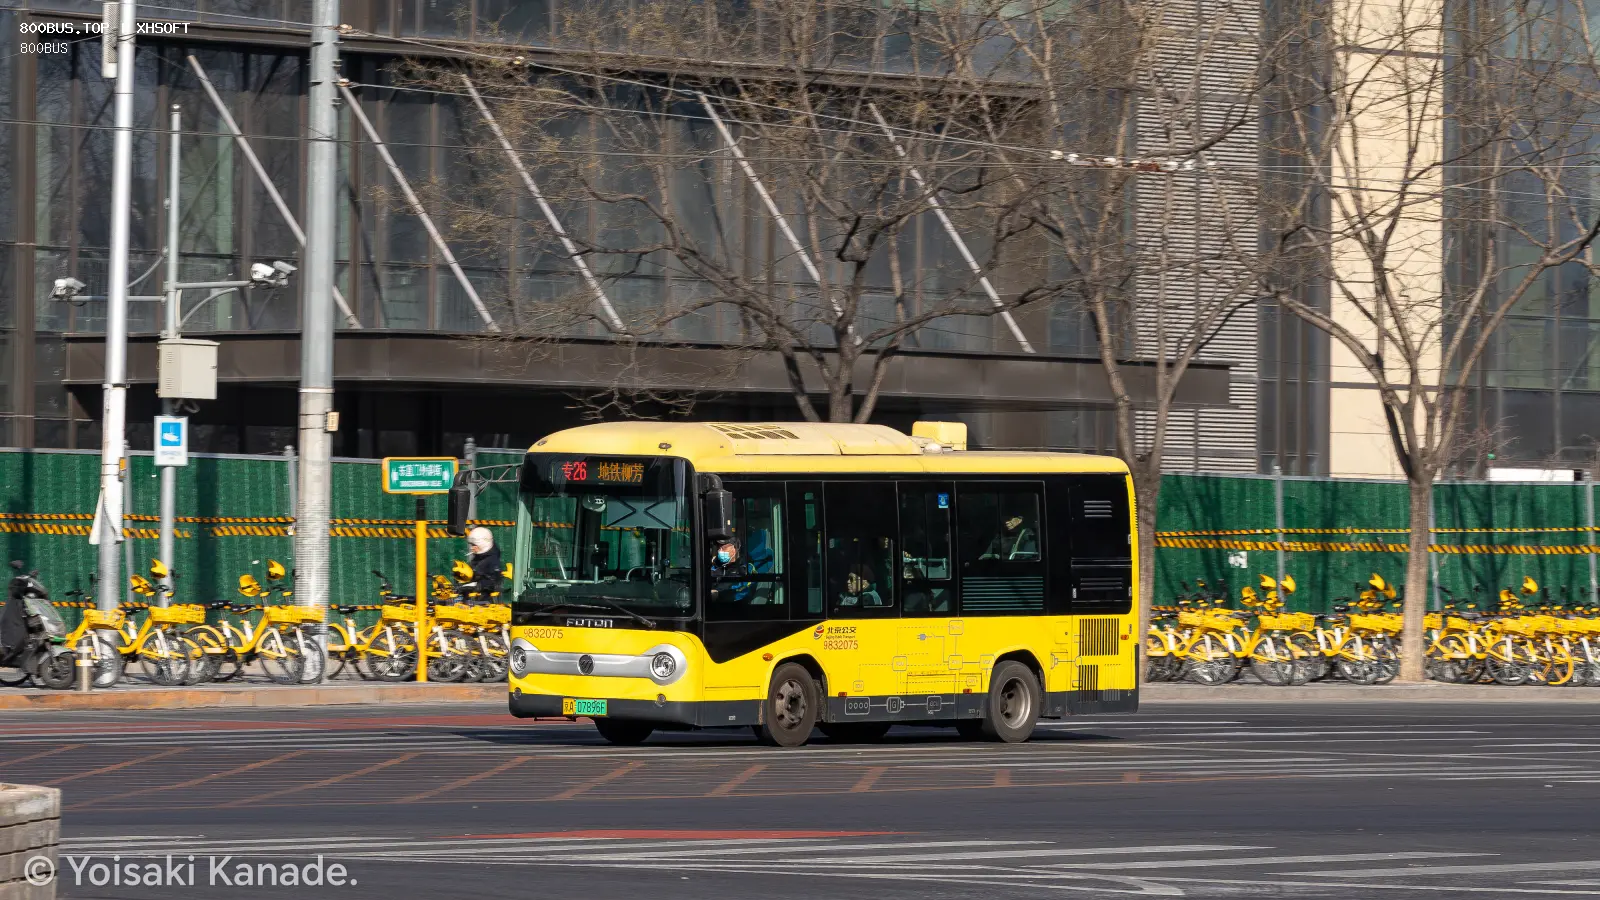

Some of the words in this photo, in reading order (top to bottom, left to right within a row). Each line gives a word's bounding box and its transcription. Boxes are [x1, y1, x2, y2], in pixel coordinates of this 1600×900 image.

[561, 461, 587, 481] 专26
[597, 462, 644, 482] 地铁柳芳
[566, 618, 613, 628] FOTON
[523, 628, 564, 639] 9832075
[827, 626, 857, 634] 北京公交
[823, 640, 858, 650] 9832075
